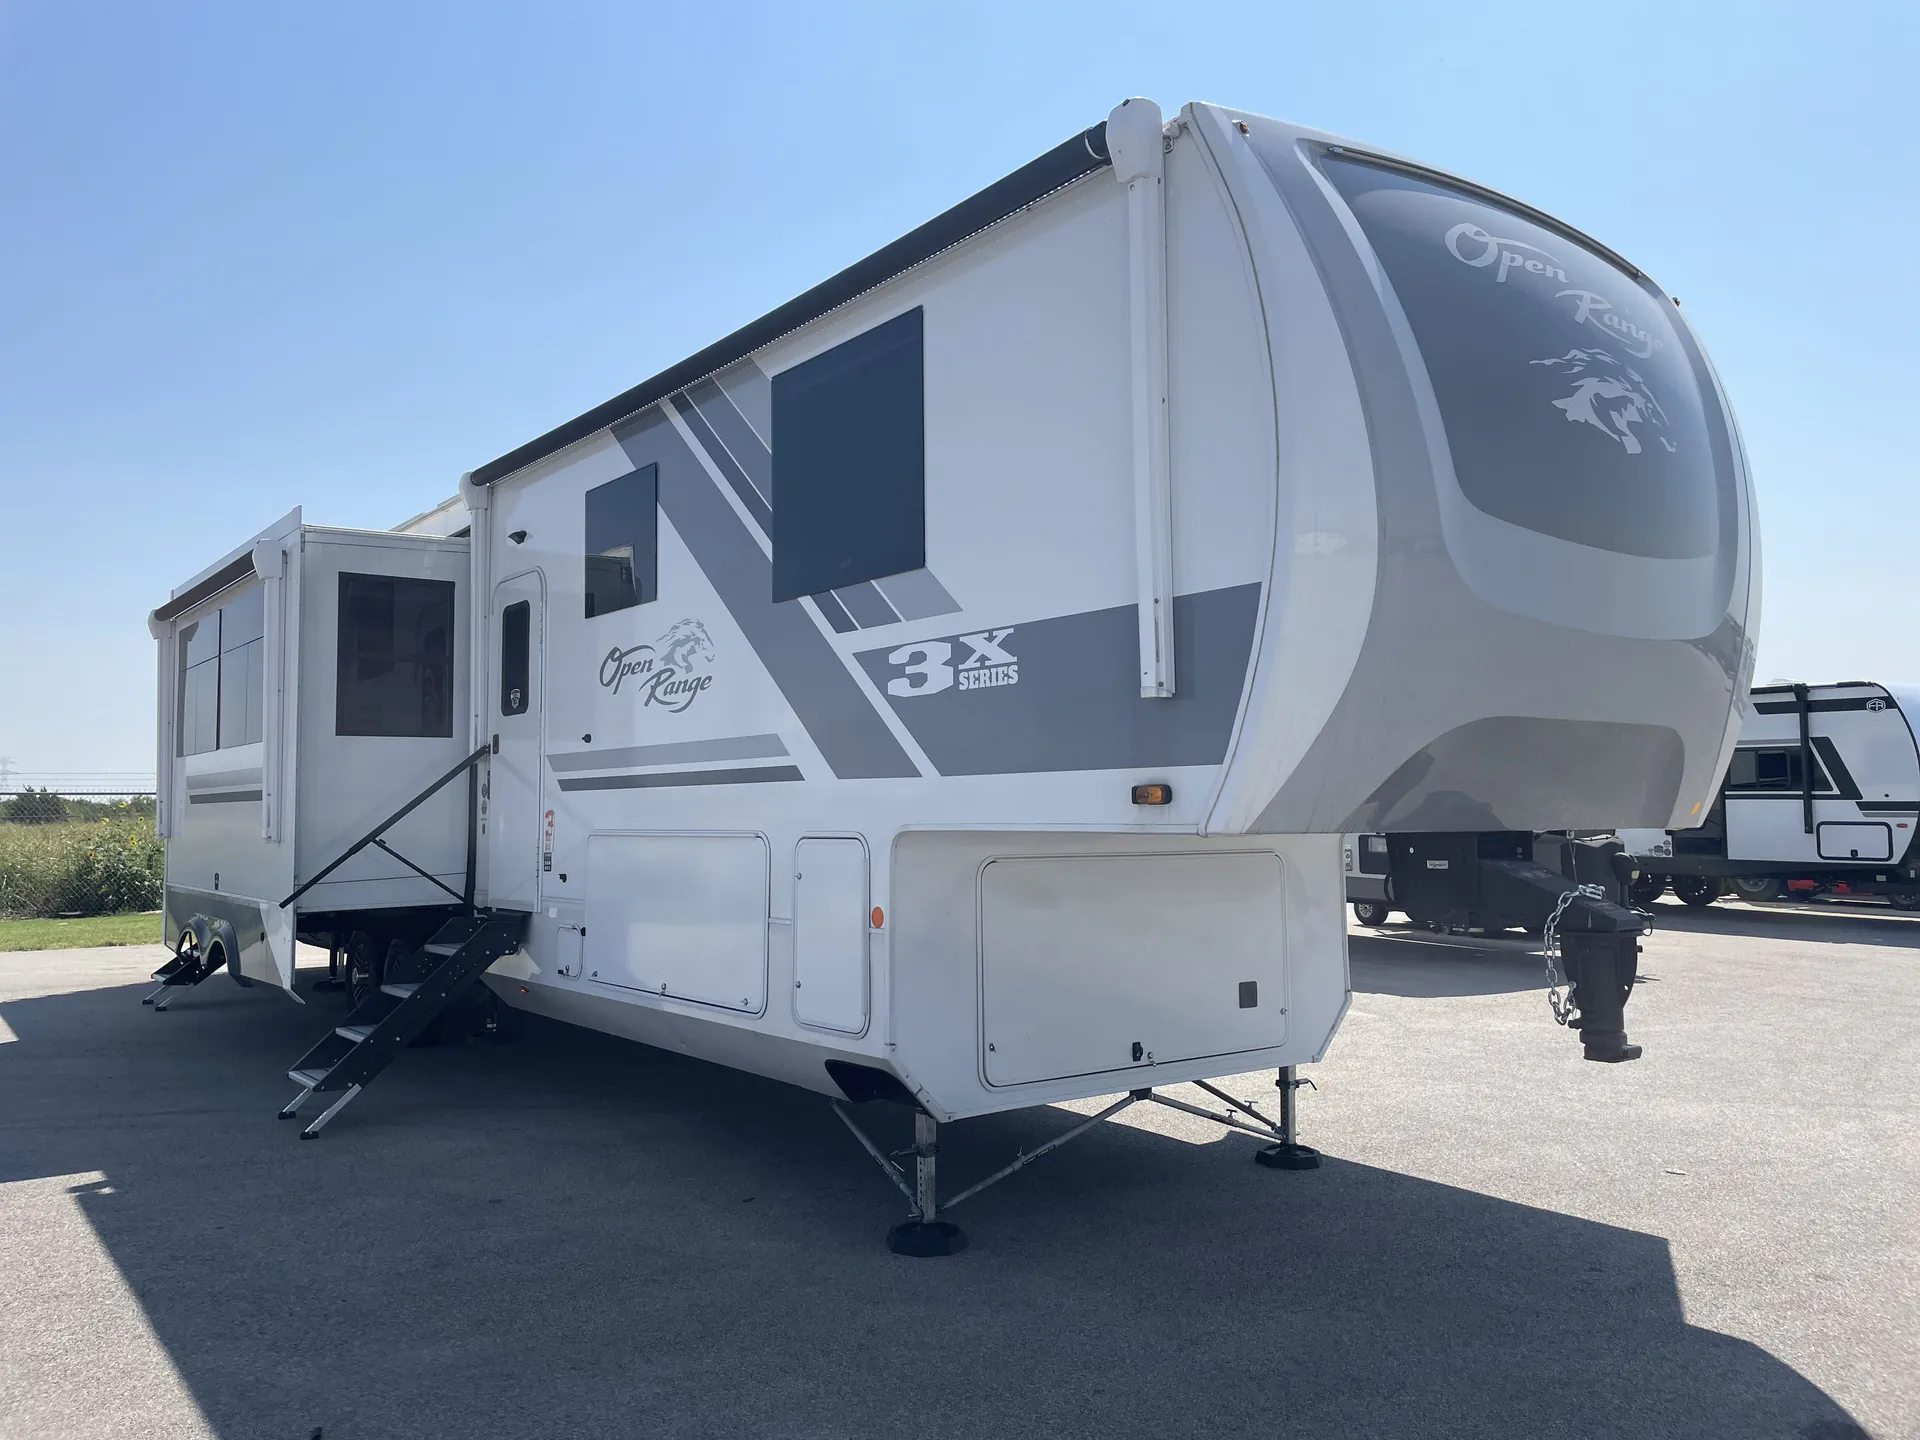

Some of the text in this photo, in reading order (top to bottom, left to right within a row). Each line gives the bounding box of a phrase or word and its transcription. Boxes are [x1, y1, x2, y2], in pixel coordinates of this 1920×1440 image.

[1444, 222, 1570, 283] Open
[1553, 289, 1664, 360] Range
[599, 644, 656, 695] Open
[638, 667, 713, 714] Range
[958, 664, 1019, 691] SERIES
